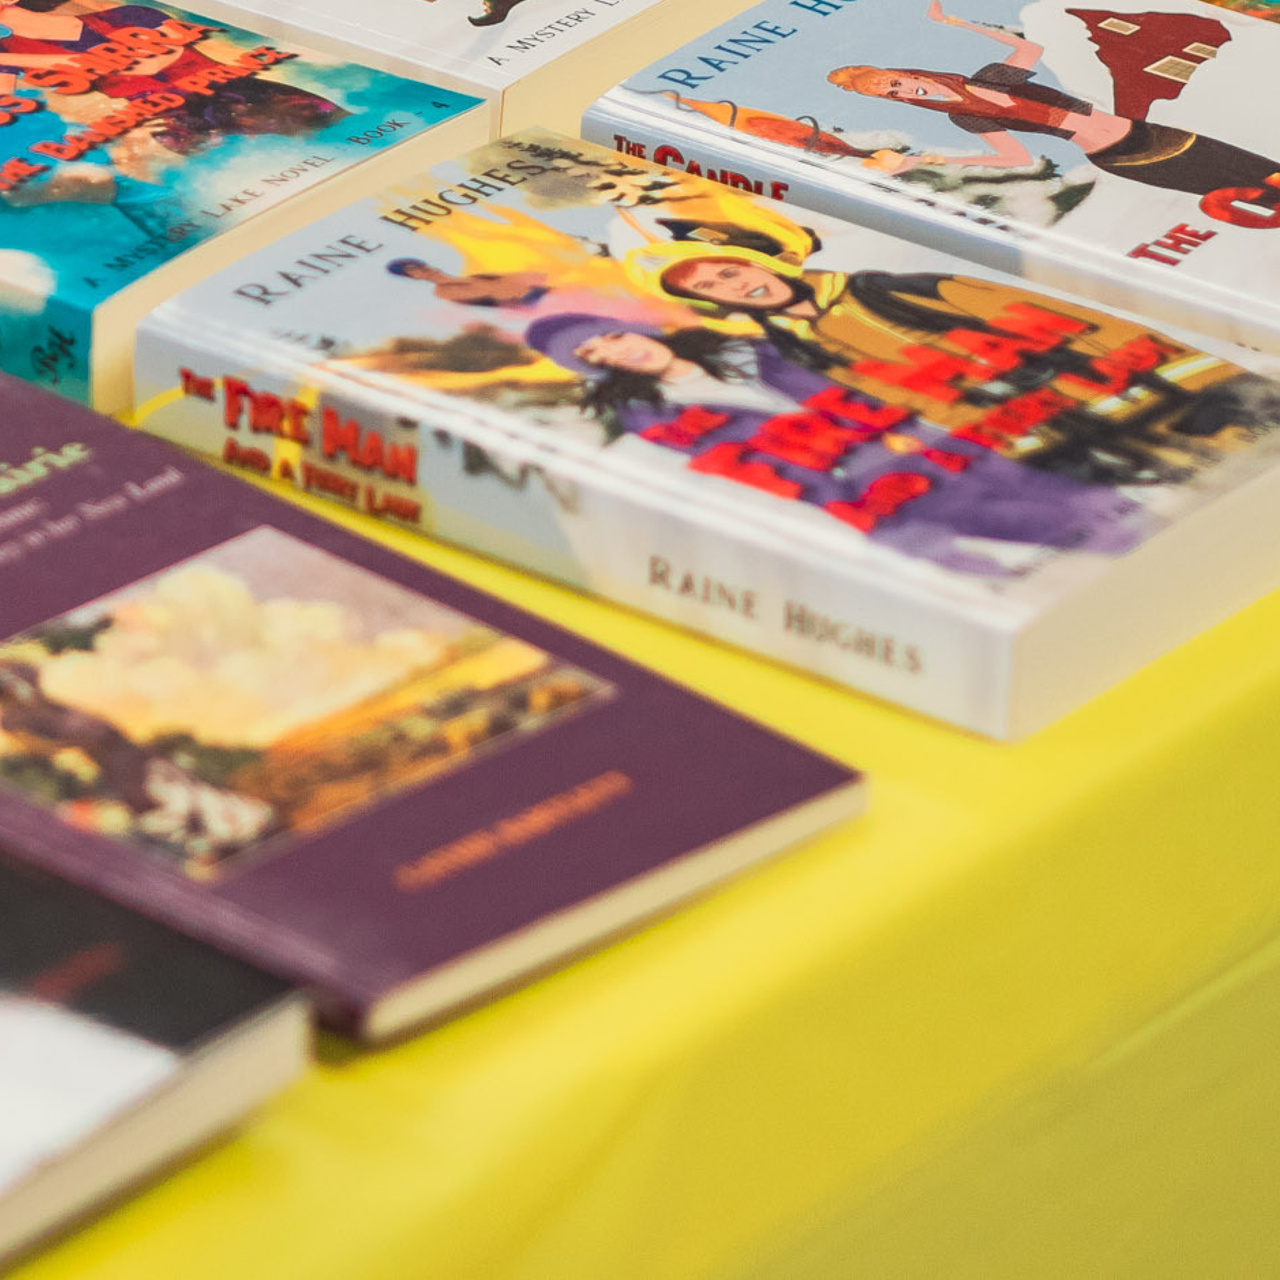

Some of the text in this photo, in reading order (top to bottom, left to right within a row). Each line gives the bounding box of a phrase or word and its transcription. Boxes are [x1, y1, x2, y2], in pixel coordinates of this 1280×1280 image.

[487, 53, 511, 68] A
[506, 6, 597, 55] MYSTERY
[658, 19, 798, 90] RAINE
[105, 219, 204, 276] MYSTERY
[200, 188, 266, 220] LAKE
[264, 152, 336, 187] NOVEL
[347, 117, 411, 148] BOOK
[233, 157, 553, 307] RAINE HUGHES
[1126, 222, 1219, 267] THE
[322, 406, 418, 485] MAN
[648, 554, 924, 674] RAINE HUGHES
